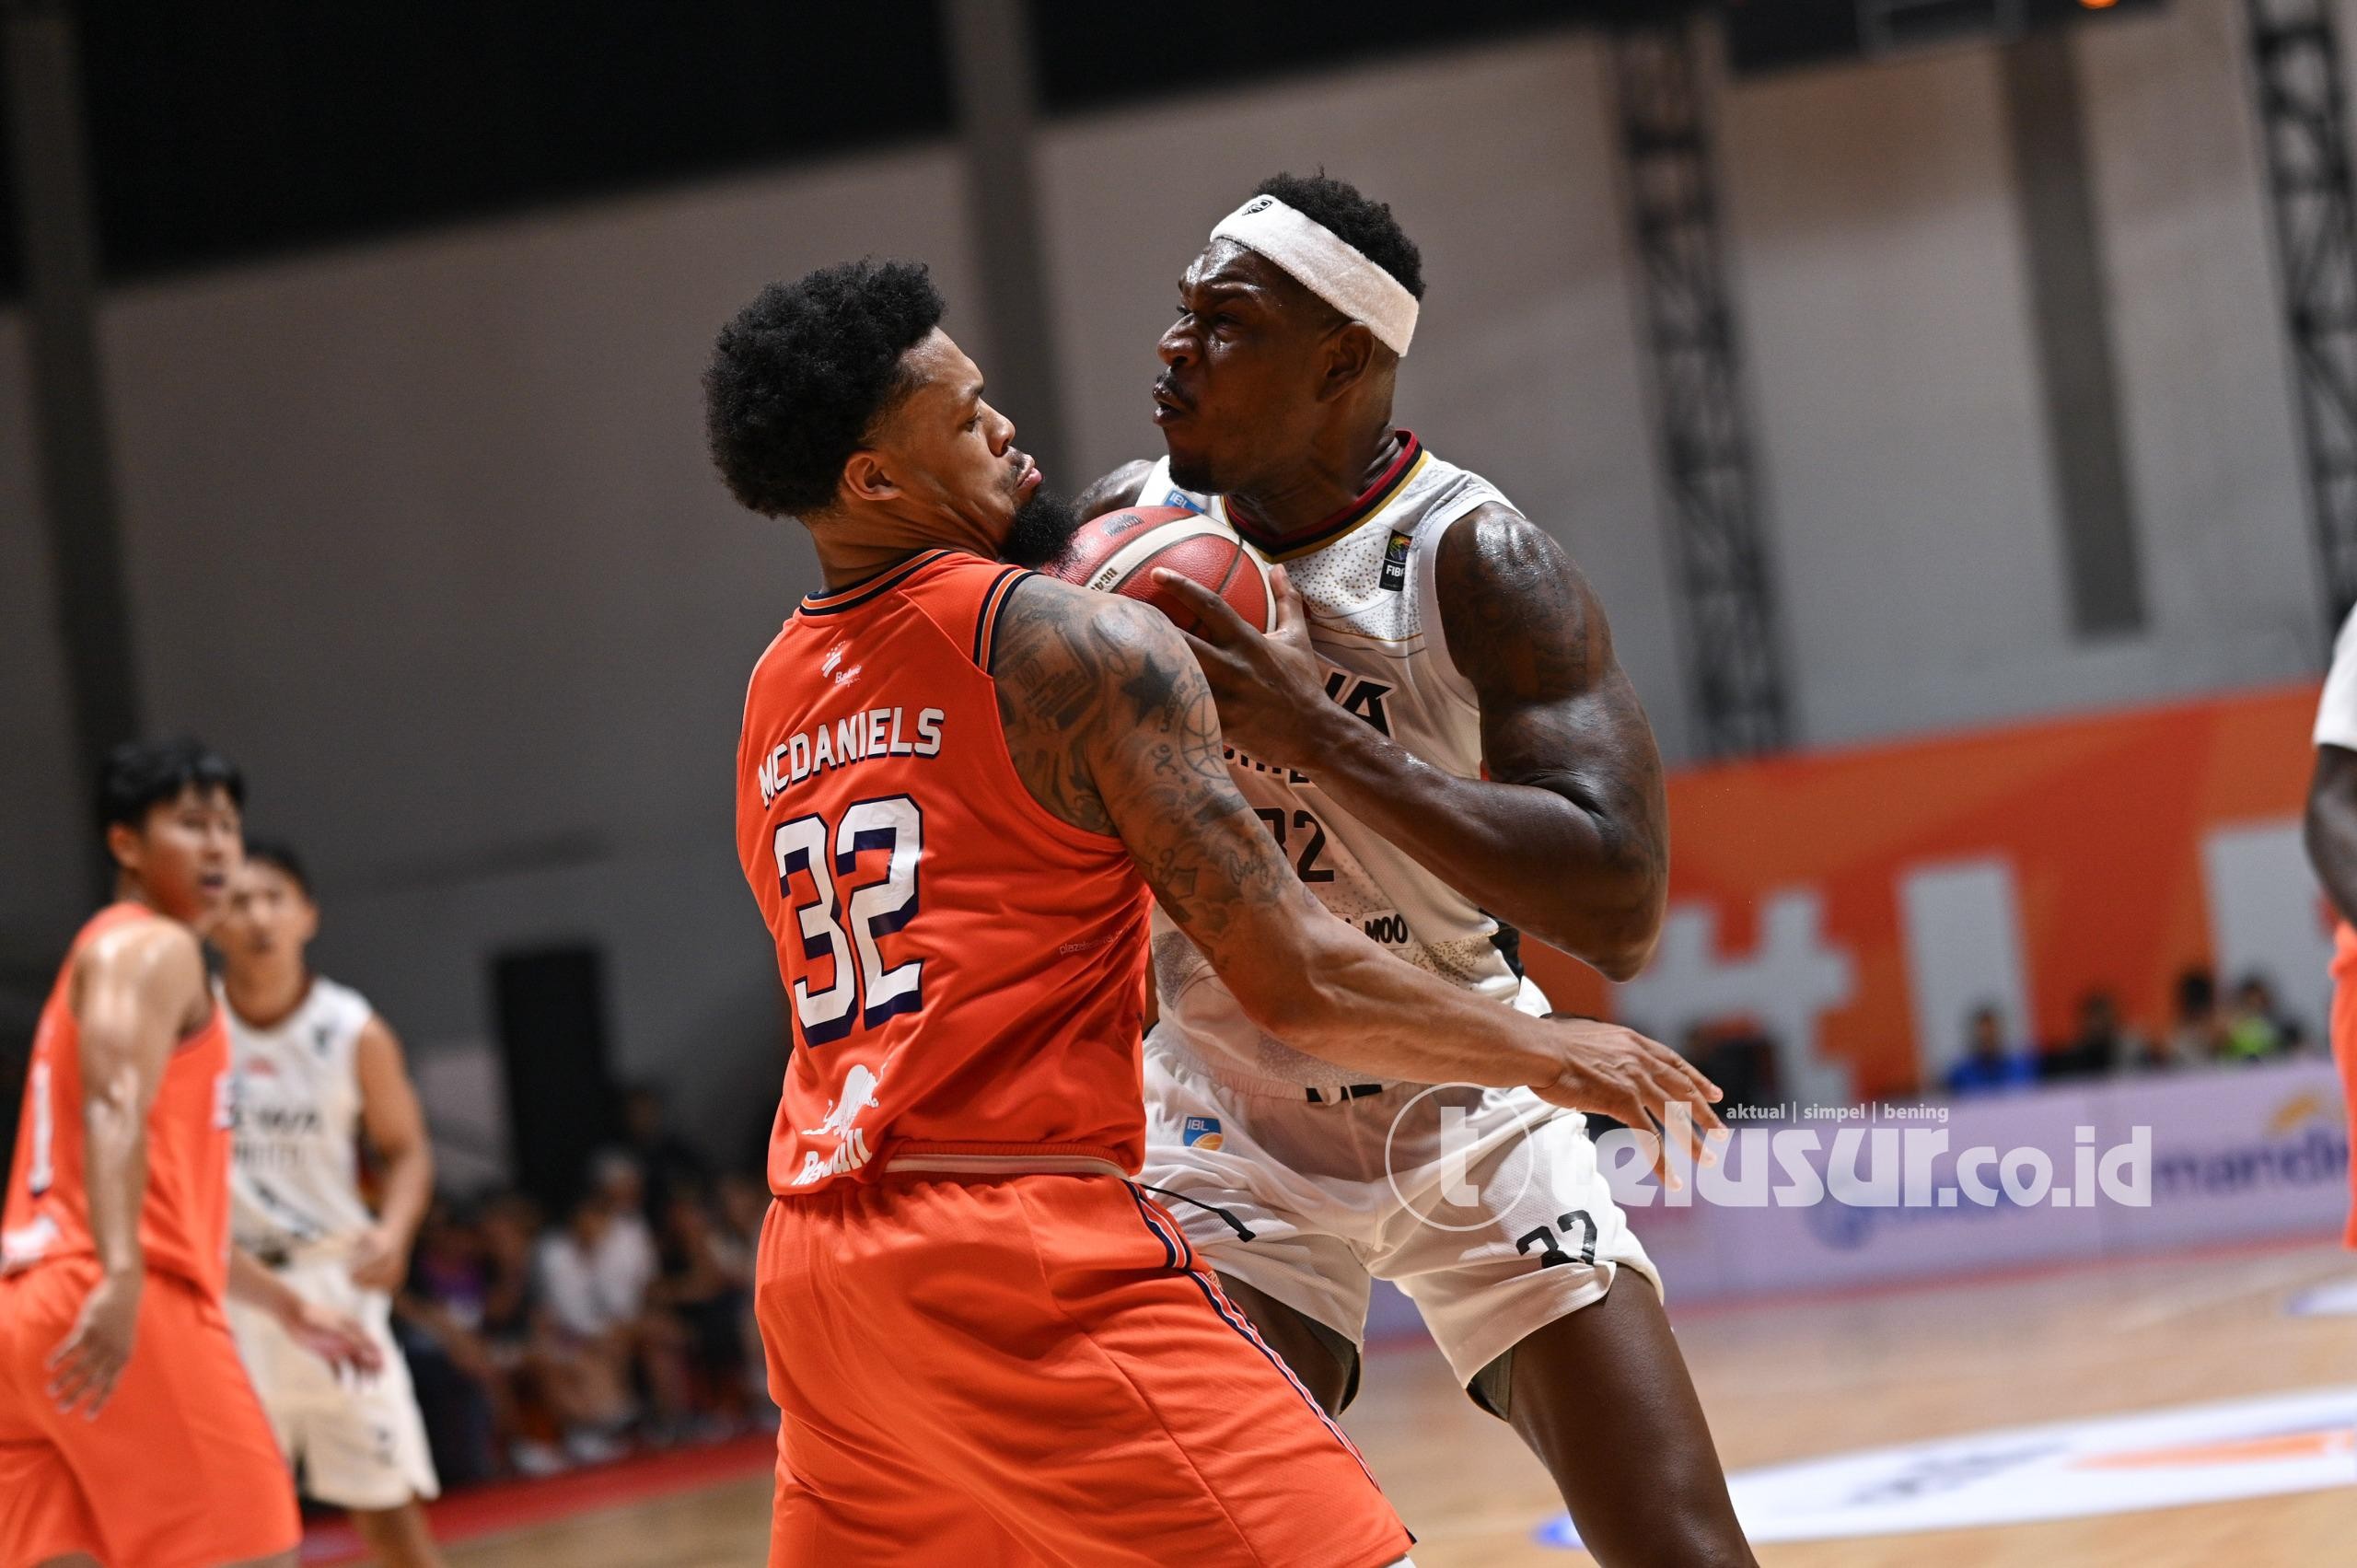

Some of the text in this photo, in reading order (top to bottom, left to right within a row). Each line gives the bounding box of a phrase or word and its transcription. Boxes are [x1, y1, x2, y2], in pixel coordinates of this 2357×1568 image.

[1091, 567, 1119, 592] BG4
[759, 707, 945, 810] MCDANIELS
[773, 793, 923, 1048] 32
[1187, 1119, 1209, 1132] IBL
